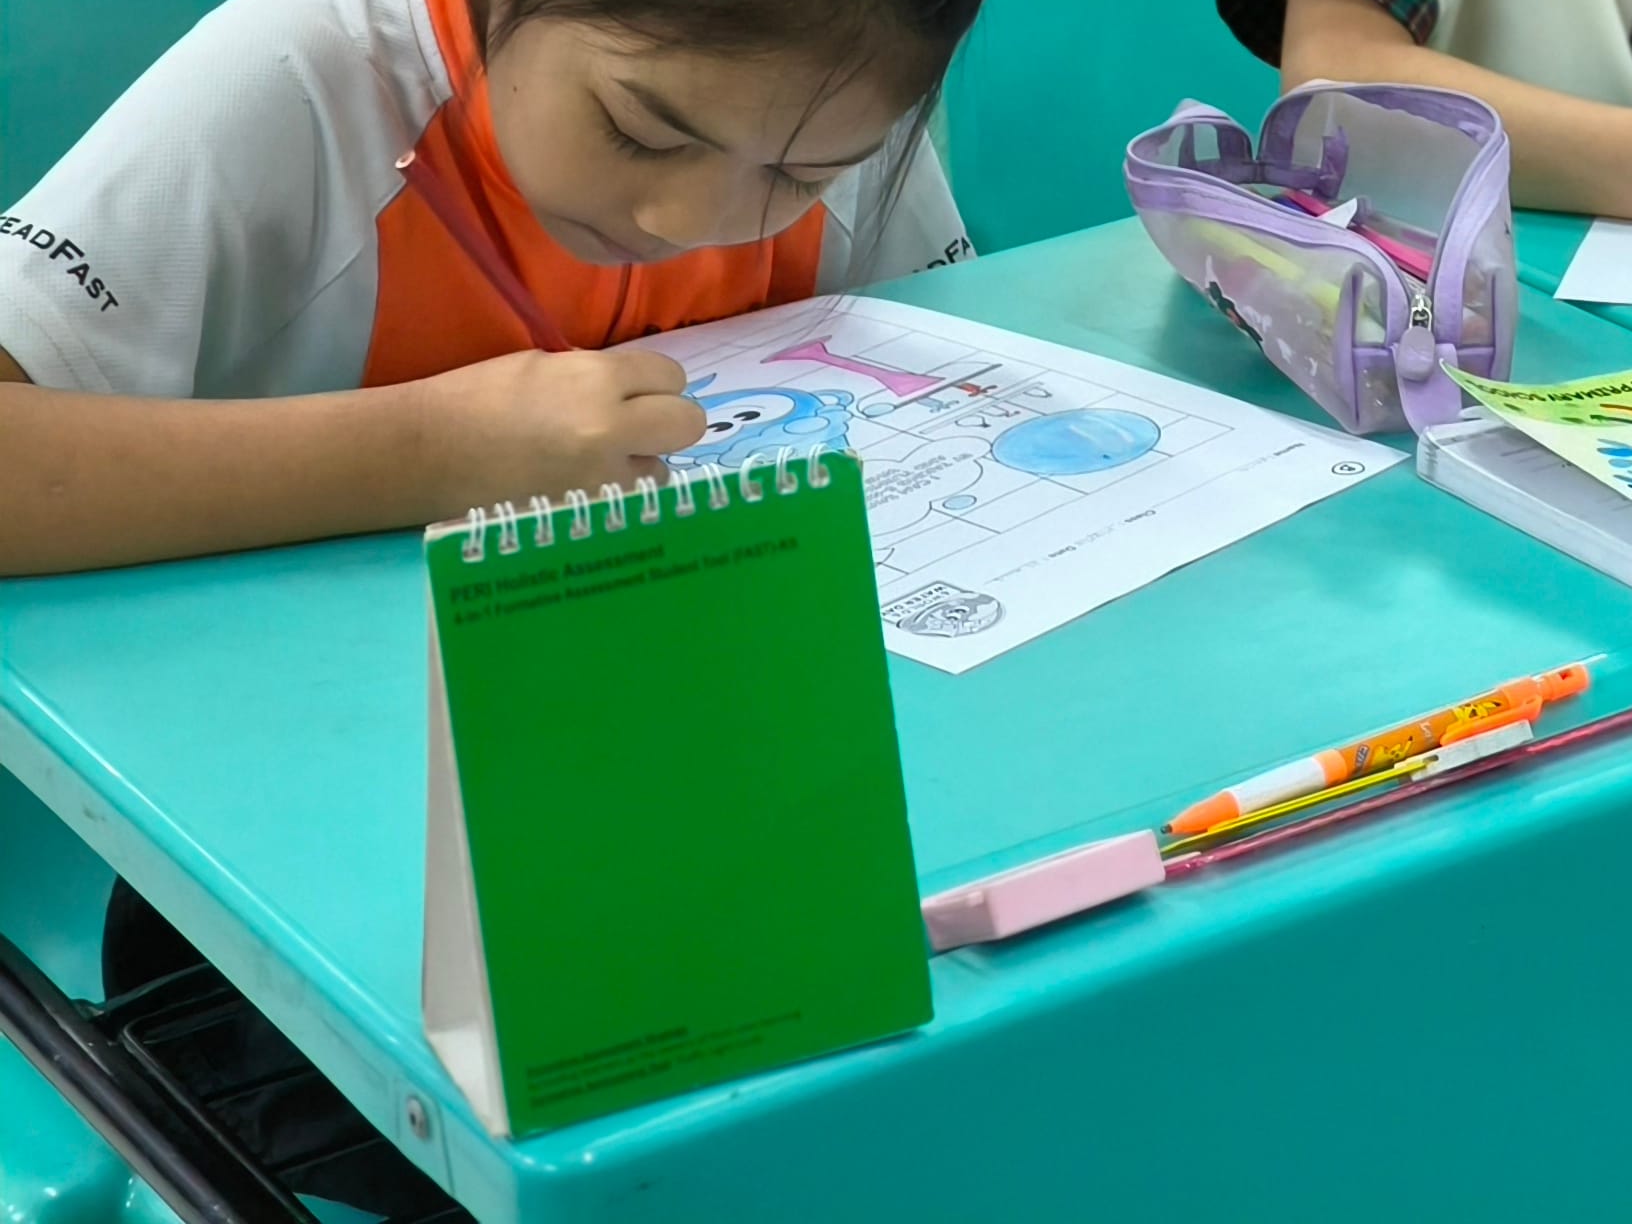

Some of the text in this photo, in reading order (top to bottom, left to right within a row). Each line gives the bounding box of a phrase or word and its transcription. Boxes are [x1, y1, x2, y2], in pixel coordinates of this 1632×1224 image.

[450, 544, 665, 606] PERI Holistic Assessment
[494, 589, 563, 618] Formative
[564, 571, 647, 602] Assessment
